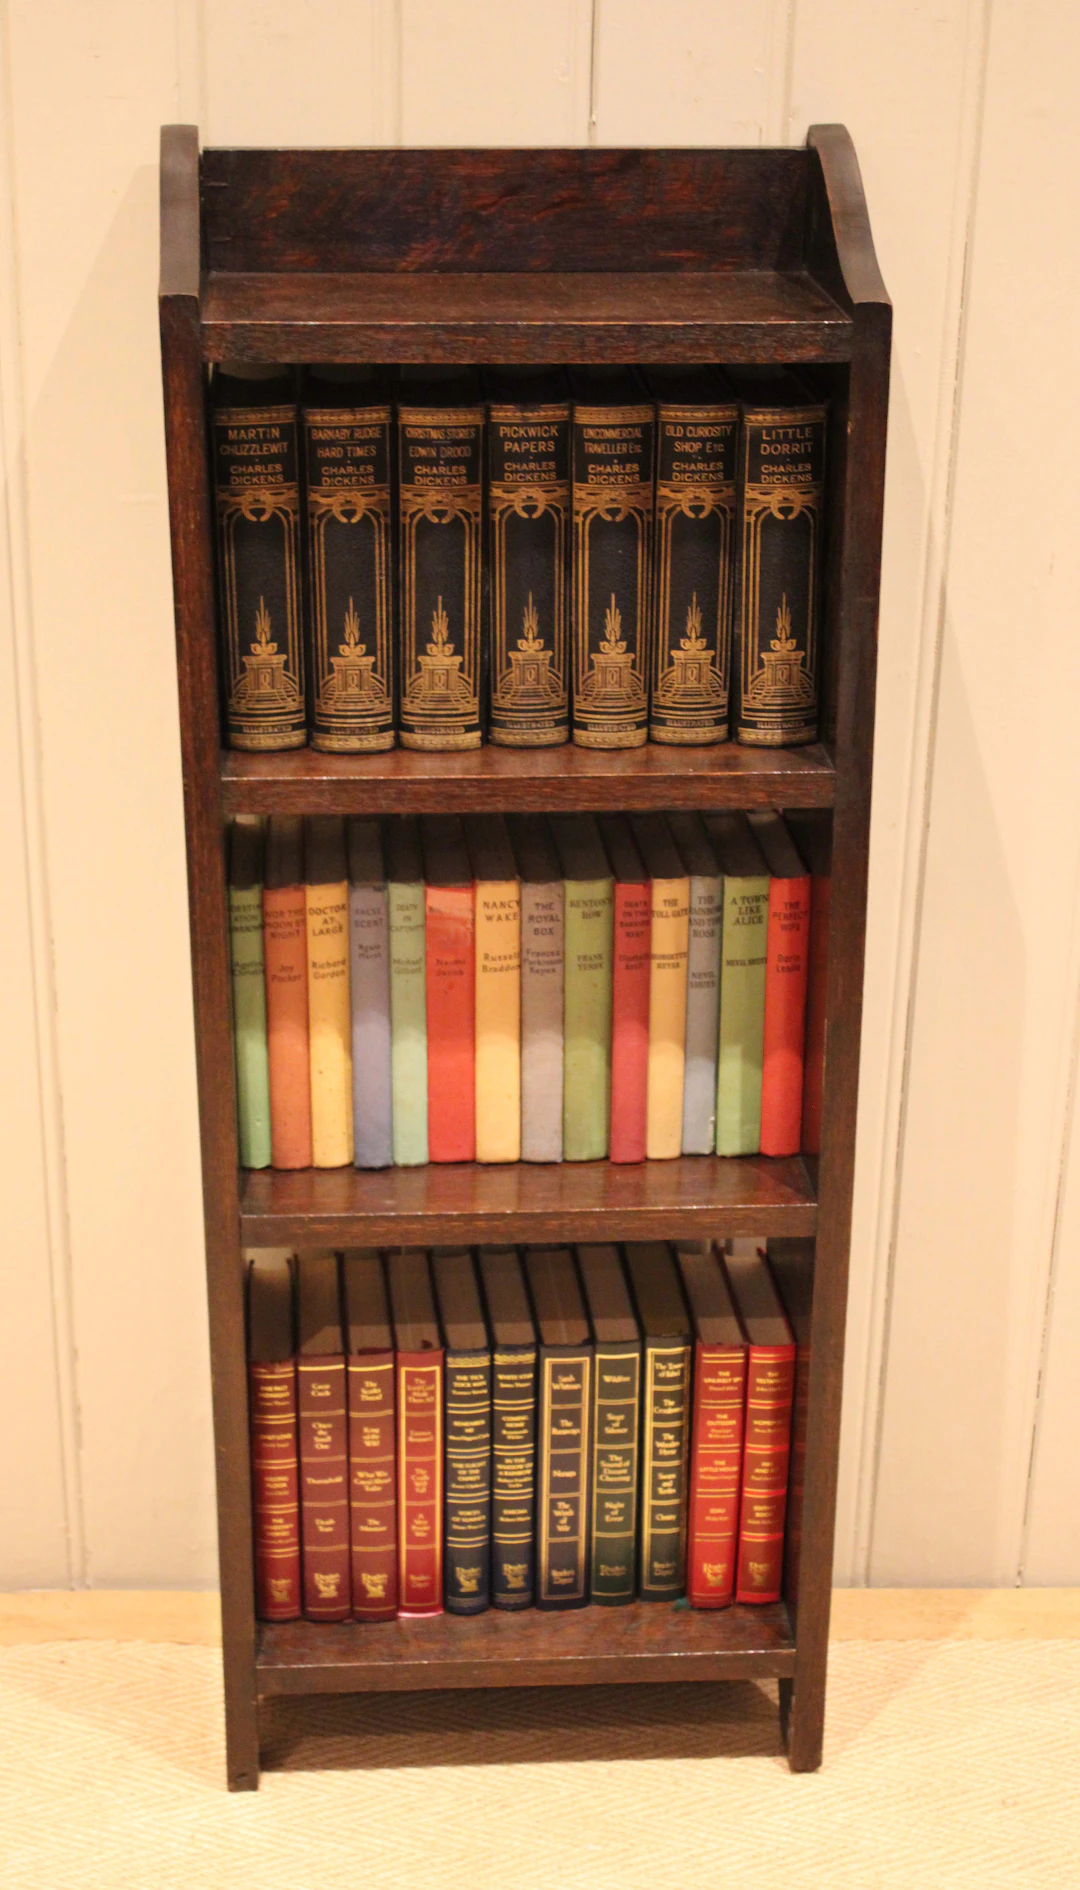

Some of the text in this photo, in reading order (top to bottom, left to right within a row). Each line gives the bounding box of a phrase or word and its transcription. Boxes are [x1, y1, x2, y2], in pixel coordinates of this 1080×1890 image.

[228, 427, 280, 440] MARTIN
[312, 426, 382, 440] BARNABY RUDGE
[405, 427, 476, 440] CHRISTMAS STORIES
[500, 426, 559, 438] PICKWICK
[583, 427, 643, 439] UNCOMMERCIAL
[665, 425, 733, 438] OLD CURIOSITY
[761, 427, 813, 440] LITTLE
[219, 441, 289, 456] CHUZZLEWIT
[316, 445, 377, 458] HARD TIMES
[409, 446, 472, 458] EDWIN DROOD
[503, 441, 555, 453] PAPERS
[584, 442, 628, 454] TRAVELLER
[673, 441, 702, 453] SHOP
[760, 442, 813, 455] DORRIT
[230, 463, 283, 474] CHARLES
[321, 465, 374, 475] CHARLES
[414, 465, 466, 475] CHARLES
[504, 461, 556, 471] CHARLES
[588, 463, 640, 474] CHARLES
[672, 461, 724, 471] CHARLES
[760, 463, 812, 474] CHARLES
[230, 474, 284, 485] DICKENS
[322, 475, 375, 486] DICKENS
[414, 475, 467, 486] DICKENS
[504, 471, 557, 482] DICKENS
[588, 473, 640, 484] DICKENS
[672, 471, 724, 481] DICKENS
[760, 473, 812, 484] DICKENS
[482, 899, 520, 910] NANCY
[663, 899, 679, 907] THE
[697, 895, 715, 905] THE
[730, 894, 769, 906] A TOWN
[309, 904, 347, 916] DOCTOR
[395, 904, 419, 912] DEATH
[534, 902, 555, 911] THE
[738, 905, 761, 916] LIKE
[322, 917, 334, 926] AT
[354, 918, 383, 928] SCENT
[403, 914, 412, 922] IN
[485, 913, 519, 922] WAKE
[528, 914, 561, 923] ROYAL
[733, 915, 764, 926] ALICE
[270, 930, 301, 940] NIGHT
[312, 925, 344, 937] LARGE
[533, 927, 554, 936] BOX
[692, 929, 715, 938] ROSE
[577, 953, 604, 962] FRANK
[311, 958, 346, 969] Richard
[313, 969, 346, 980] Gordon
[691, 971, 716, 980] NEVIL
